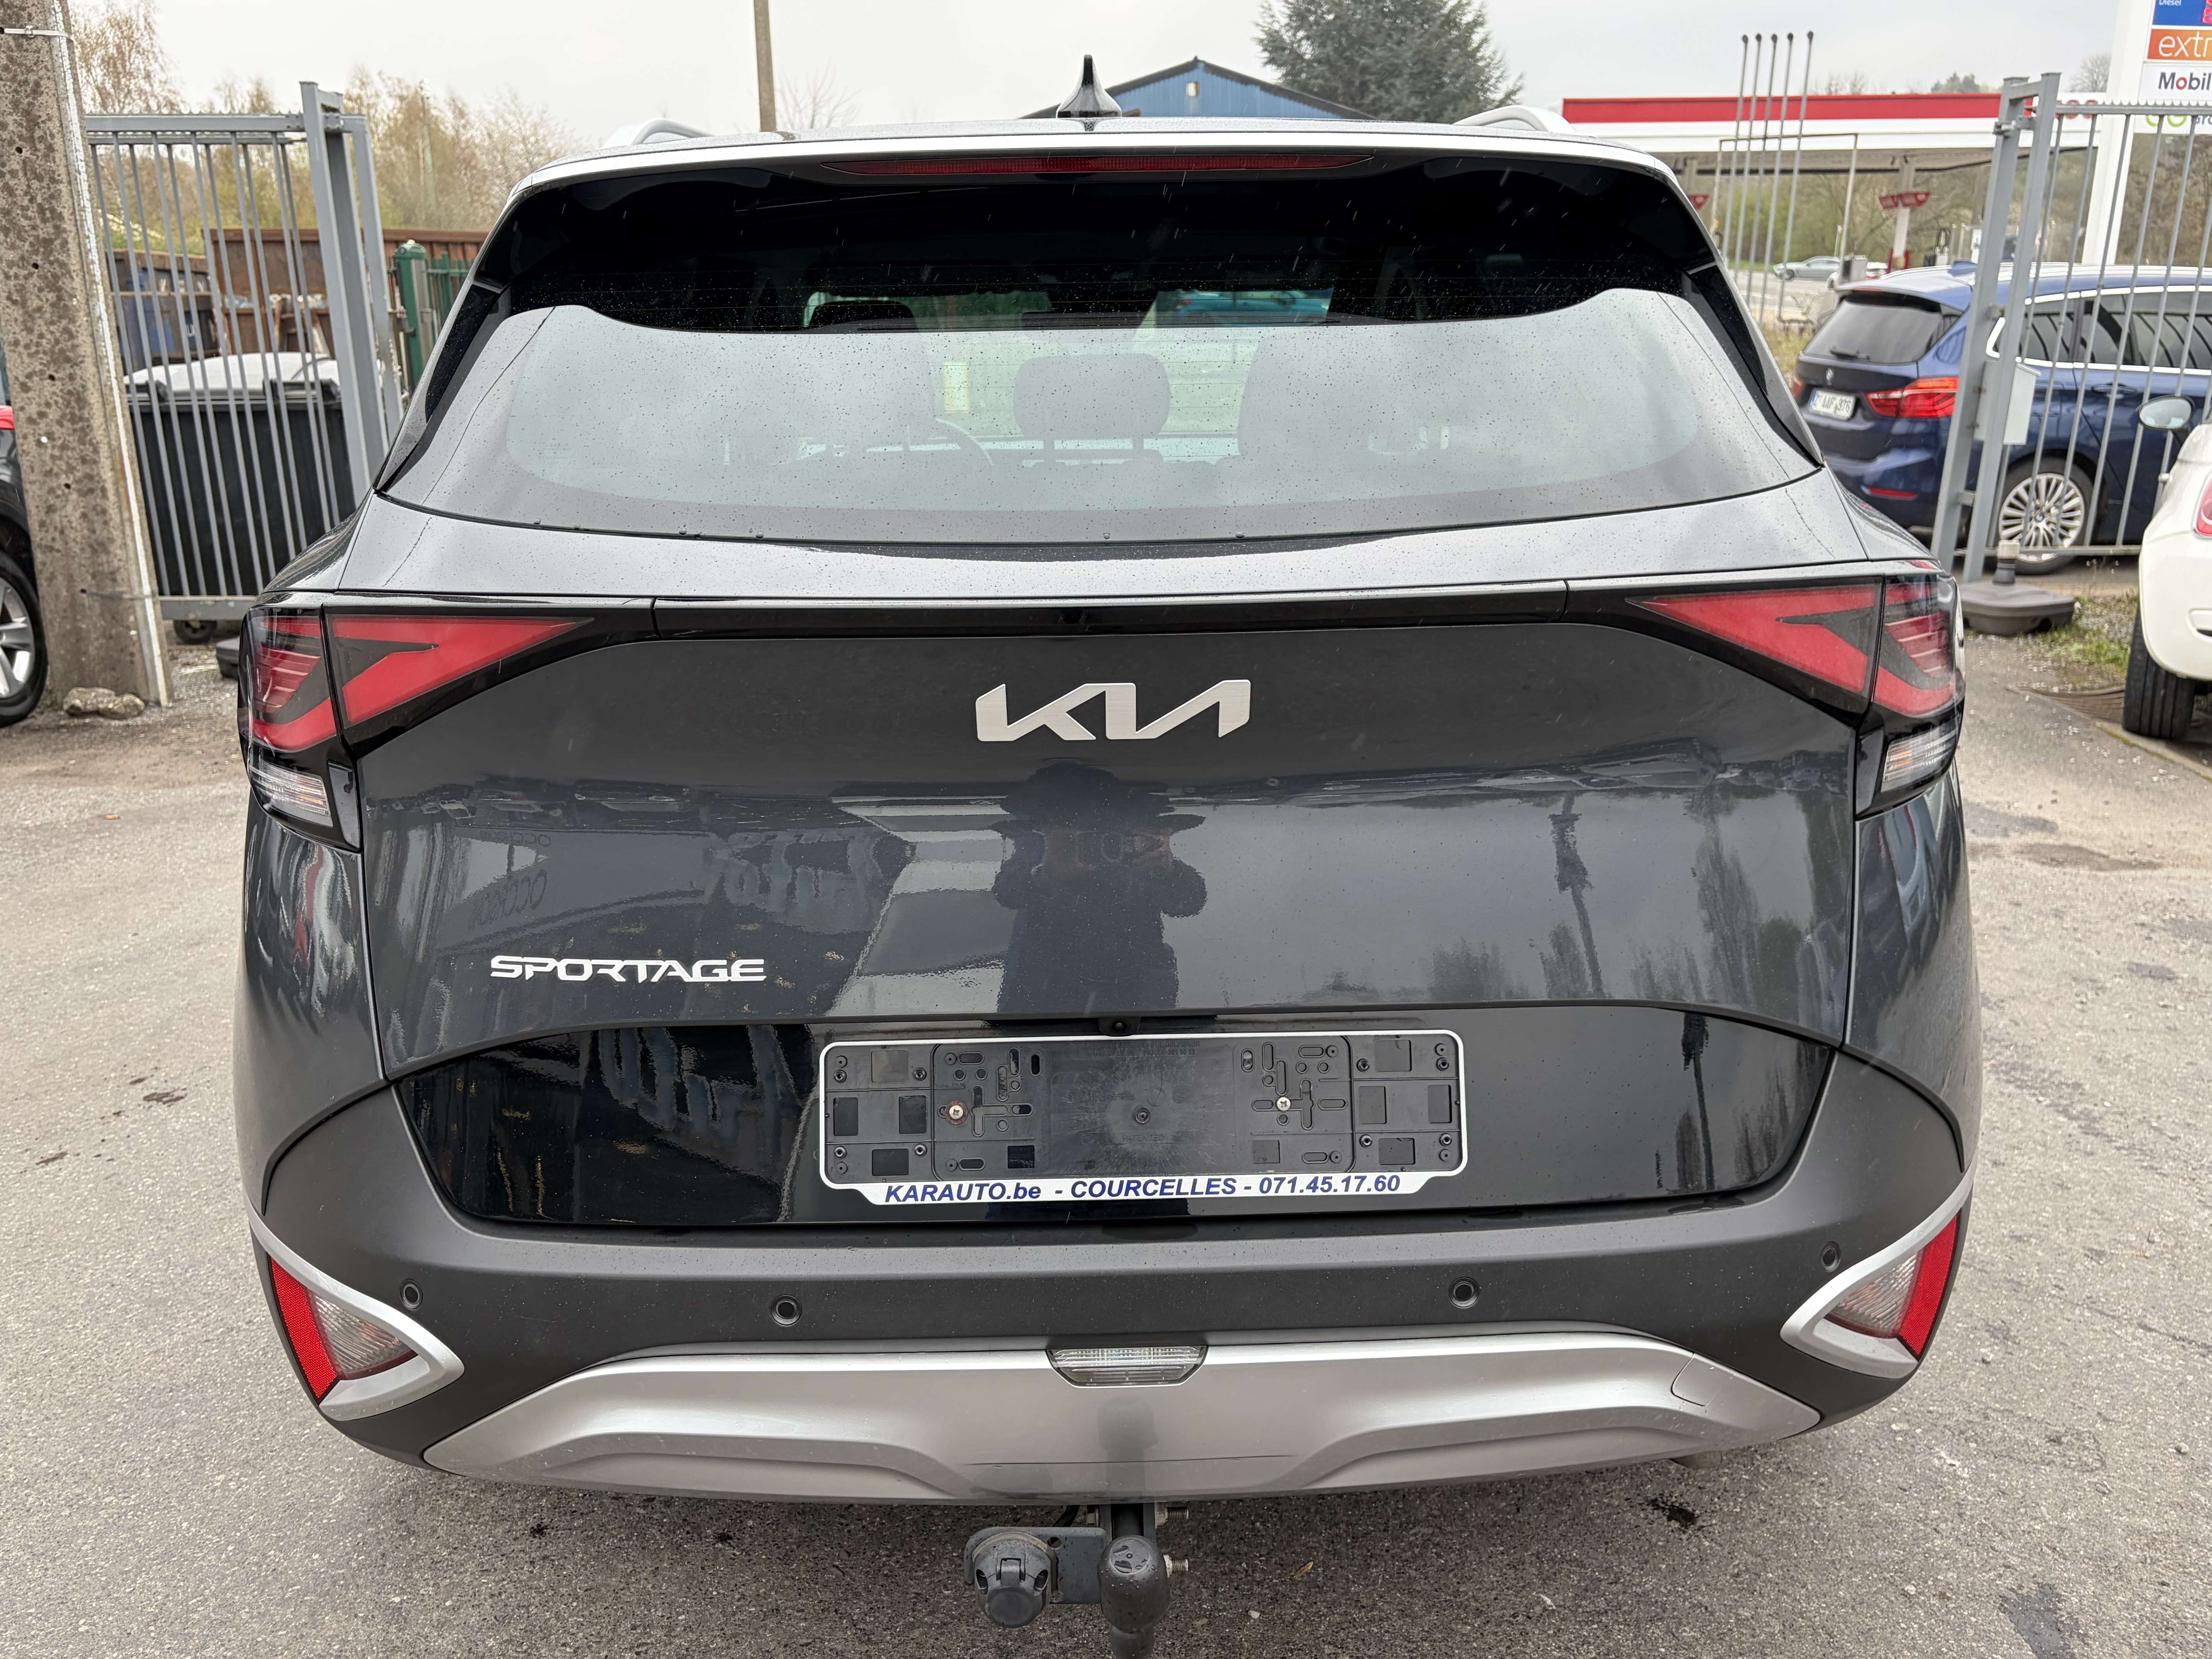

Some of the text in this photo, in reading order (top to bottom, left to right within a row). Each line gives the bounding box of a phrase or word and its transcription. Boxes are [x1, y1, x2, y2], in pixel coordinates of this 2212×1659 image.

[975, 679, 1251, 742] KIA
[490, 955, 767, 983] SPORTAGE
[885, 1183, 1041, 1202] KARAUTO.be
[1071, 1178, 1237, 1198] COURCELLES
[1259, 1175, 1400, 1194] 071.45.17.60
